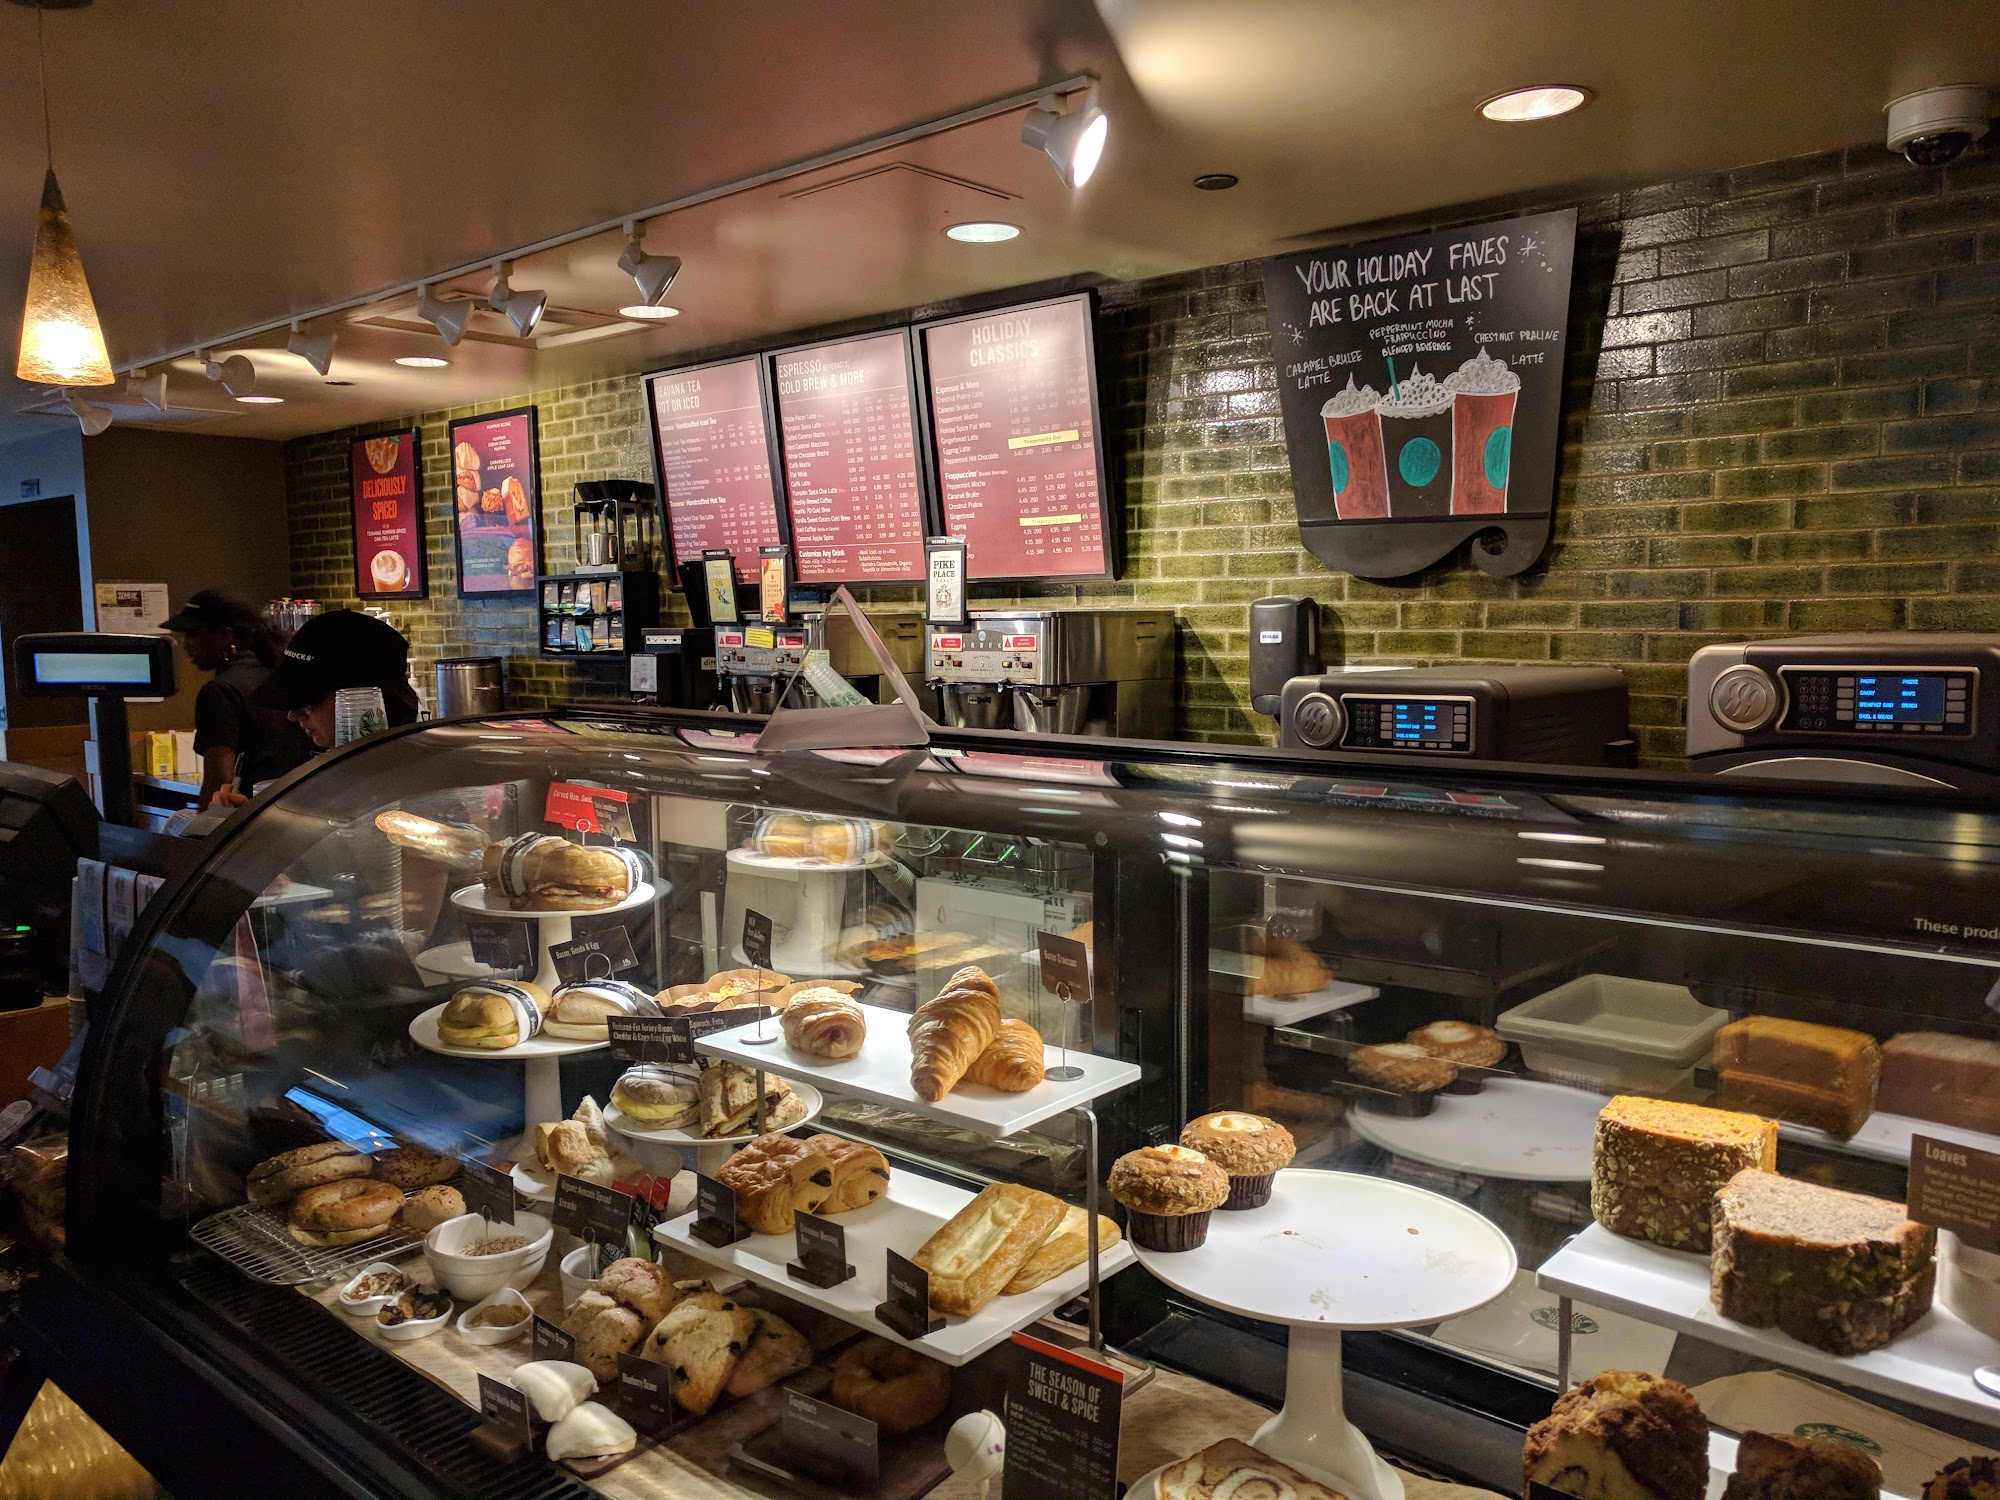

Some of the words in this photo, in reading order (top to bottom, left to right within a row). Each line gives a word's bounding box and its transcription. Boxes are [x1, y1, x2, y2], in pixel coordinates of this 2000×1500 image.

[1295, 259, 1351, 296] YOUR
[1356, 247, 1433, 286] HOLIDAY
[1449, 235, 1510, 271] FAVES
[1309, 298, 1342, 329] ARE
[1349, 289, 1400, 323] BACK
[1409, 282, 1439, 311] AT
[1446, 272, 1499, 304] LAST
[971, 318, 1032, 346] HOLIDAY
[1369, 320, 1424, 340] PEPPERMINT
[1426, 318, 1454, 330] MOCHA
[1384, 330, 1447, 345] FRAPPUCCINO
[1474, 331, 1515, 345] CHESTNUT
[1519, 329, 1560, 342] PRALINE
[969, 340, 1040, 367] CLASSICS
[1381, 344, 1415, 358] BLENDED
[1415, 341, 1451, 353] BEVERAGE
[1285, 358, 1328, 378] CARAMEL
[1328, 350, 1363, 369] BRULEE
[1511, 352, 1546, 366] LATTE
[779, 359, 821, 378] ESPRESSO
[780, 381, 801, 395] COLD
[803, 376, 829, 392] BREW
[831, 374, 838, 388] &
[840, 369, 865, 386] MORE
[936, 385, 959, 395] Espresso
[960, 382, 965, 390] &
[966, 380, 980, 389] More
[1298, 371, 1331, 390] LATTE
[656, 383, 686, 398] TEAVANA
[688, 380, 702, 394] TEA
[936, 394, 956, 404] Chestnut
[956, 392, 971, 401] Praline
[971, 390, 984, 399] Latte
[657, 401, 671, 414] HOT
[671, 399, 682, 411] OR
[683, 396, 700, 409] ICED
[937, 405, 956, 415] Caramel
[971, 402, 983, 410] Latte
[938, 415, 963, 426] Peppermint
[963, 413, 979, 422] Mocha
[940, 425, 956, 436] Holiday
[956, 423, 969, 433] Spice
[969, 422, 978, 431] Flat
[978, 421, 992, 430] White
[941, 436, 966, 446] Gingerbread
[966, 434, 979, 442] Latte
[943, 447, 959, 456] Eggnog
[959, 445, 971, 453] Latte
[944, 457, 968, 465] Peppermint
[968, 454, 977, 462] Hot
[977, 452, 999, 461] Chocolate
[363, 475, 406, 499] DELICIOUSLY
[946, 482, 971, 491] Peppermint
[971, 480, 986, 489] Mocha
[686, 498, 709, 506] Handcrafted
[968, 501, 983, 509] Praline
[372, 500, 398, 521] SPICED
[950, 512, 975, 521] Gingerbread
[951, 523, 967, 531] Eggnog
[799, 550, 822, 558] Customize
[822, 550, 832, 558] Any
[832, 549, 846, 557] Drink
[933, 560, 955, 569] PIKE
[933, 570, 955, 578] PLACE
[1859, 701, 1882, 709] BREAKFAST
[552, 789, 569, 799] Carved
[1913, 917, 1959, 935] These
[1963, 926, 2000, 940] prod
[555, 950, 571, 960] Bacon,
[570, 944, 586, 955] Gouda
[590, 941, 600, 951] Egg
[1043, 949, 1057, 961] Butter
[611, 1021, 641, 1032] Reduced-Fat
[641, 1022, 658, 1034] Turkey
[657, 1023, 675, 1034] Bacon,
[690, 1019, 711, 1029] Spinach,
[711, 1017, 725, 1026] Feta
[613, 1031, 632, 1041] Cheddar
[661, 1034, 672, 1044] Egg
[672, 1034, 687, 1043] White
[1925, 1142, 1968, 1167] Loaves
[1029, 1362, 1048, 1384] THE
[1049, 1369, 1086, 1399] SEASON
[1088, 1385, 1101, 1403] OF
[1010, 1402, 1024, 1412] NEW
[1028, 1379, 1059, 1406] SWEET
[1060, 1394, 1069, 1411] &
[1071, 1396, 1100, 1423] SPICE
[1009, 1410, 1024, 1419] NEW
